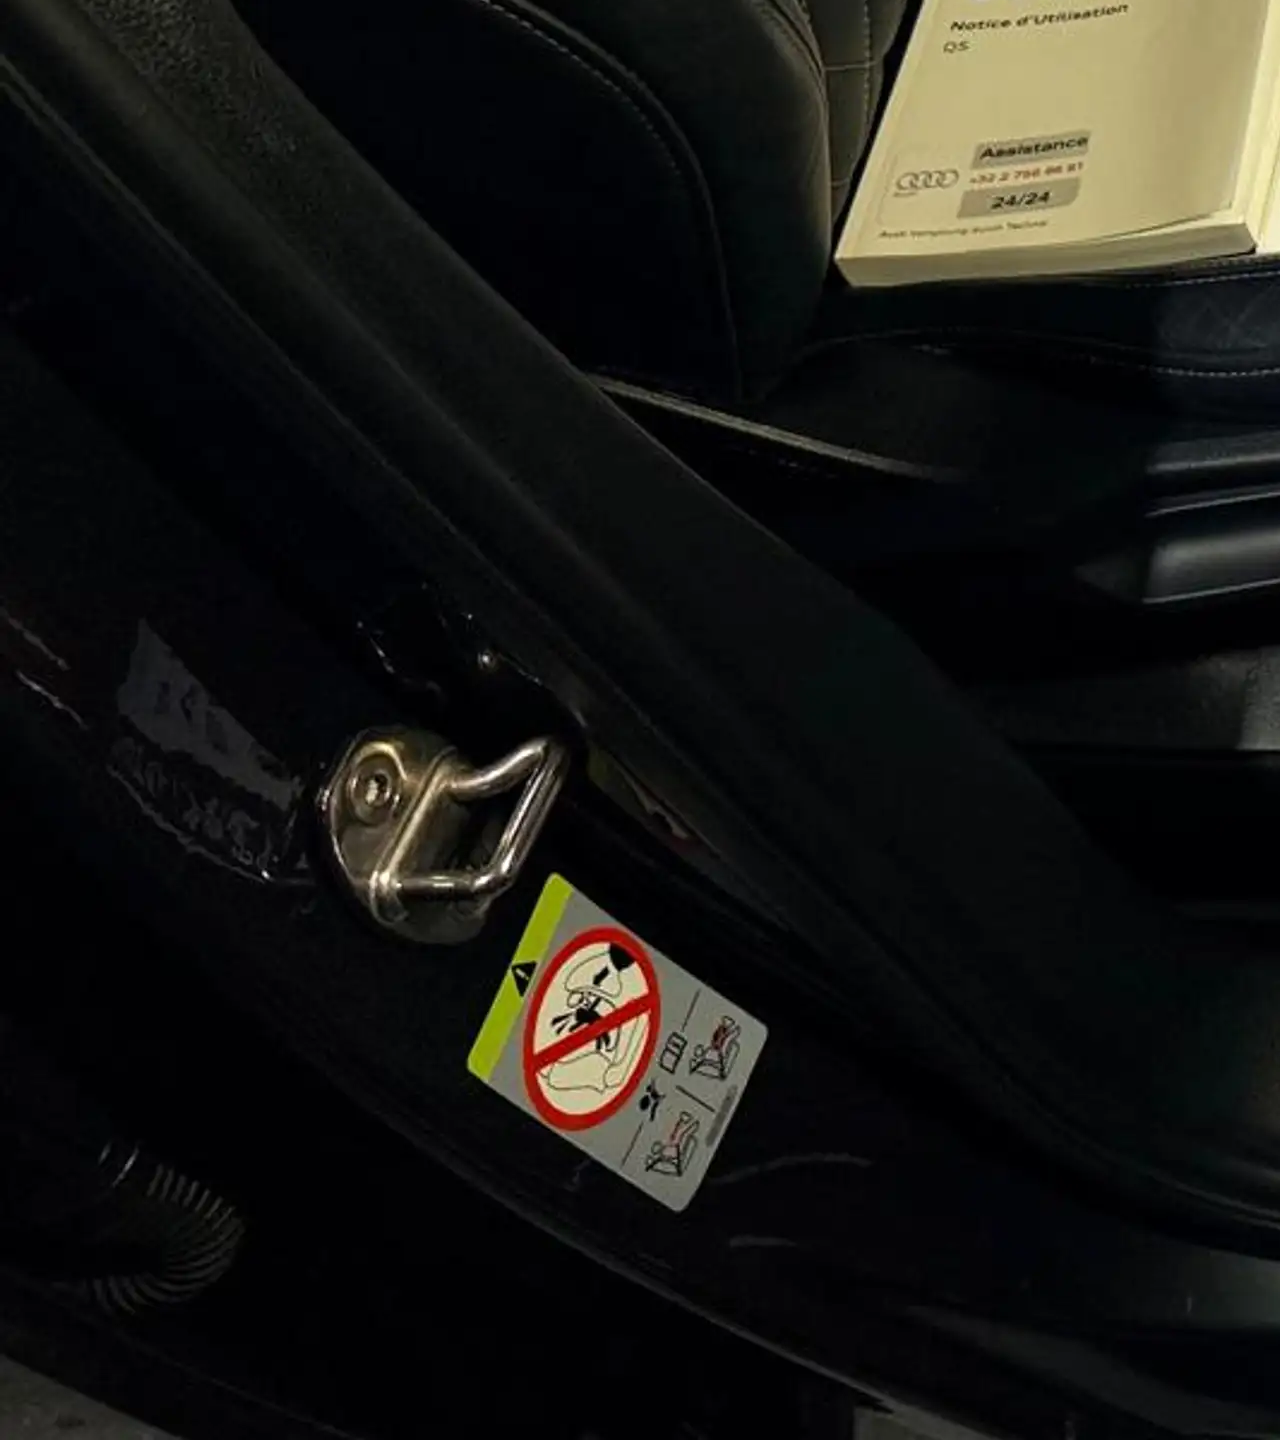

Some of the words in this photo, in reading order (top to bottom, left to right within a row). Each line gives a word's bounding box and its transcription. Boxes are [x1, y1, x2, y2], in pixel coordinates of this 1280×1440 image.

[950, 17, 1012, 32] Notice
[1016, 3, 1130, 28] d'Utilisation
[978, 135, 1090, 160] Assistance
[990, 190, 1051, 210] 24/24
